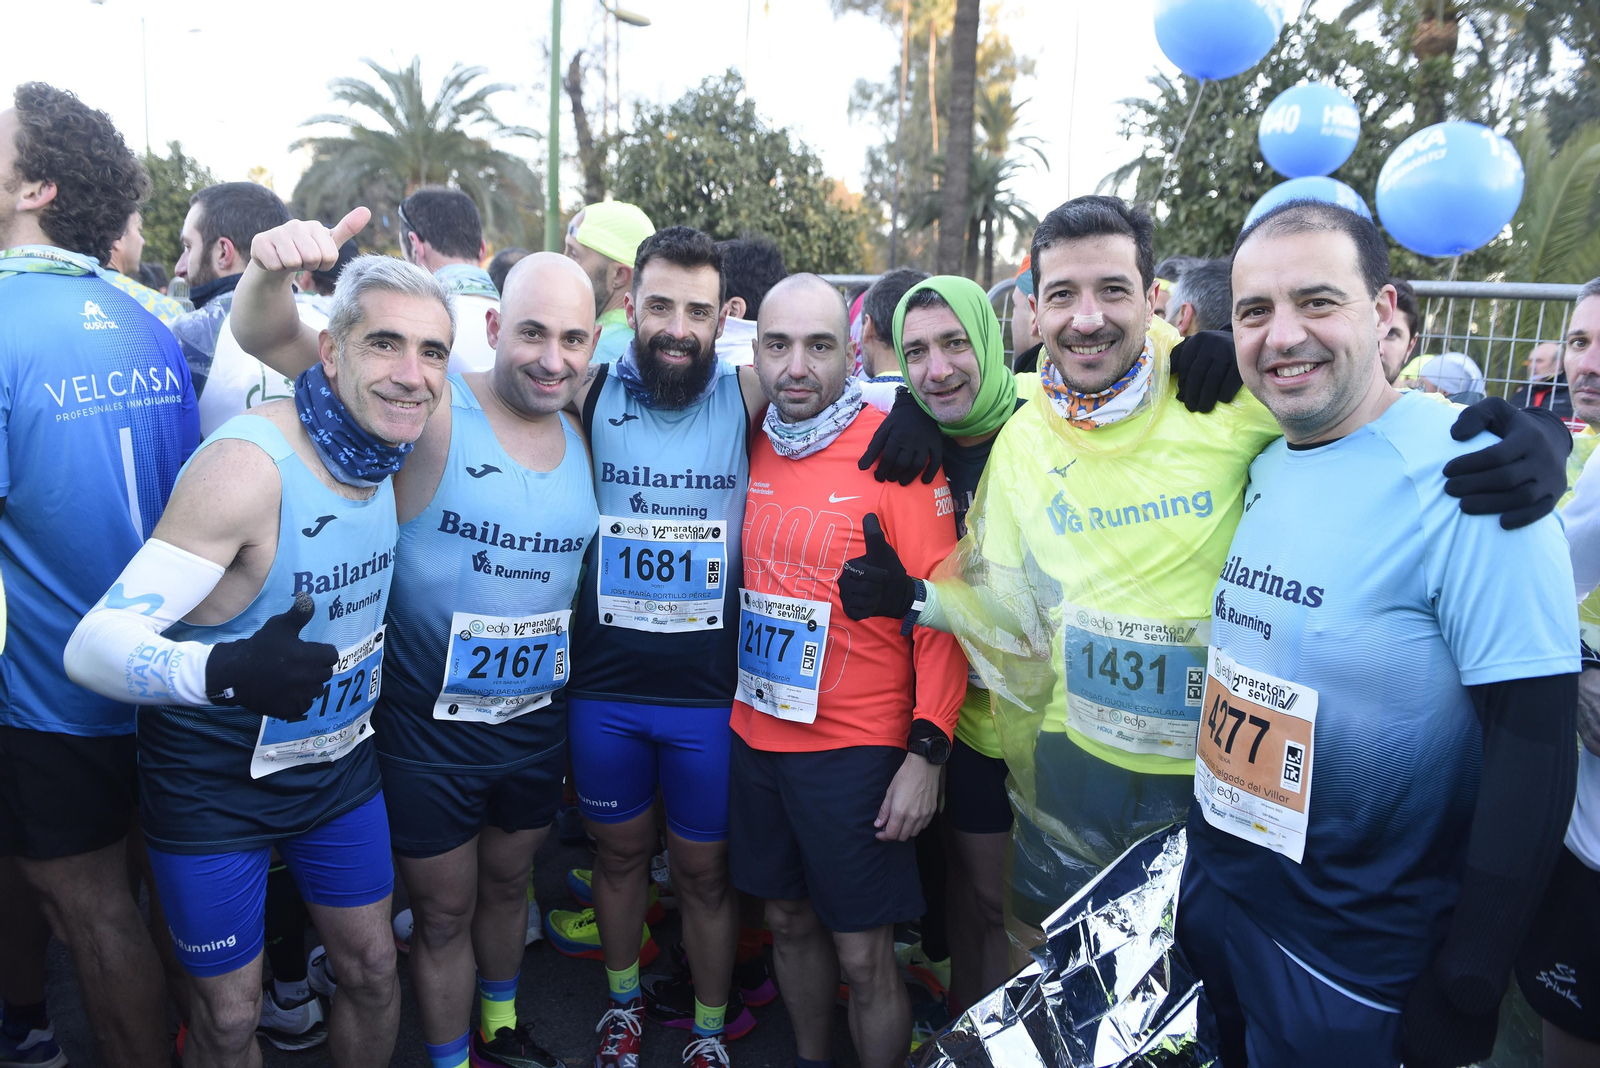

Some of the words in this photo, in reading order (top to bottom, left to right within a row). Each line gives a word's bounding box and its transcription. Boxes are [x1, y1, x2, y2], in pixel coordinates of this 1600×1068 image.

[44, 366, 181, 408] VELCASA
[601, 461, 737, 490] Bailarinas
[651, 503, 708, 519] Running
[1089, 489, 1214, 531] Running
[437, 509, 584, 553] Bailarinas
[627, 523, 649, 538] edp
[664, 525, 705, 533] maratón
[674, 531, 704, 540] sevilla
[495, 564, 551, 583] Running
[619, 546, 692, 583] 1681
[629, 590, 652, 598] MARÍA
[657, 602, 678, 613] edp
[771, 601, 807, 613] maratón
[777, 610, 806, 620] sevilla
[486, 622, 510, 636] edp
[524, 618, 556, 628] maratón
[531, 625, 557, 634] sevilla
[1090, 617, 1113, 632] edp
[1132, 622, 1184, 634] maratón
[1228, 607, 1272, 640] Running
[745, 620, 795, 662] 2177
[1144, 631, 1184, 643] sevilla
[347, 640, 372, 660] maratón
[468, 643, 548, 679] 2167
[1082, 641, 1167, 694] 1431
[451, 687, 494, 695] FERNANDO
[524, 682, 562, 693] FERNÁNDEZ
[1239, 674, 1286, 698] maratón
[286, 669, 365, 724] 172
[505, 696, 525, 706] edp
[1080, 689, 1102, 701] CESAR
[1105, 696, 1133, 710] DUQUE
[1135, 705, 1186, 717] ESCALADA
[1248, 689, 1286, 709] sevilla
[1097, 725, 1112, 735] HOKA
[1124, 715, 1146, 730] edp
[1208, 694, 1270, 764] 4277
[1217, 785, 1240, 804] edp
[1247, 783, 1261, 793] del
[1264, 787, 1290, 803] Villar
[178, 934, 237, 953] Running
